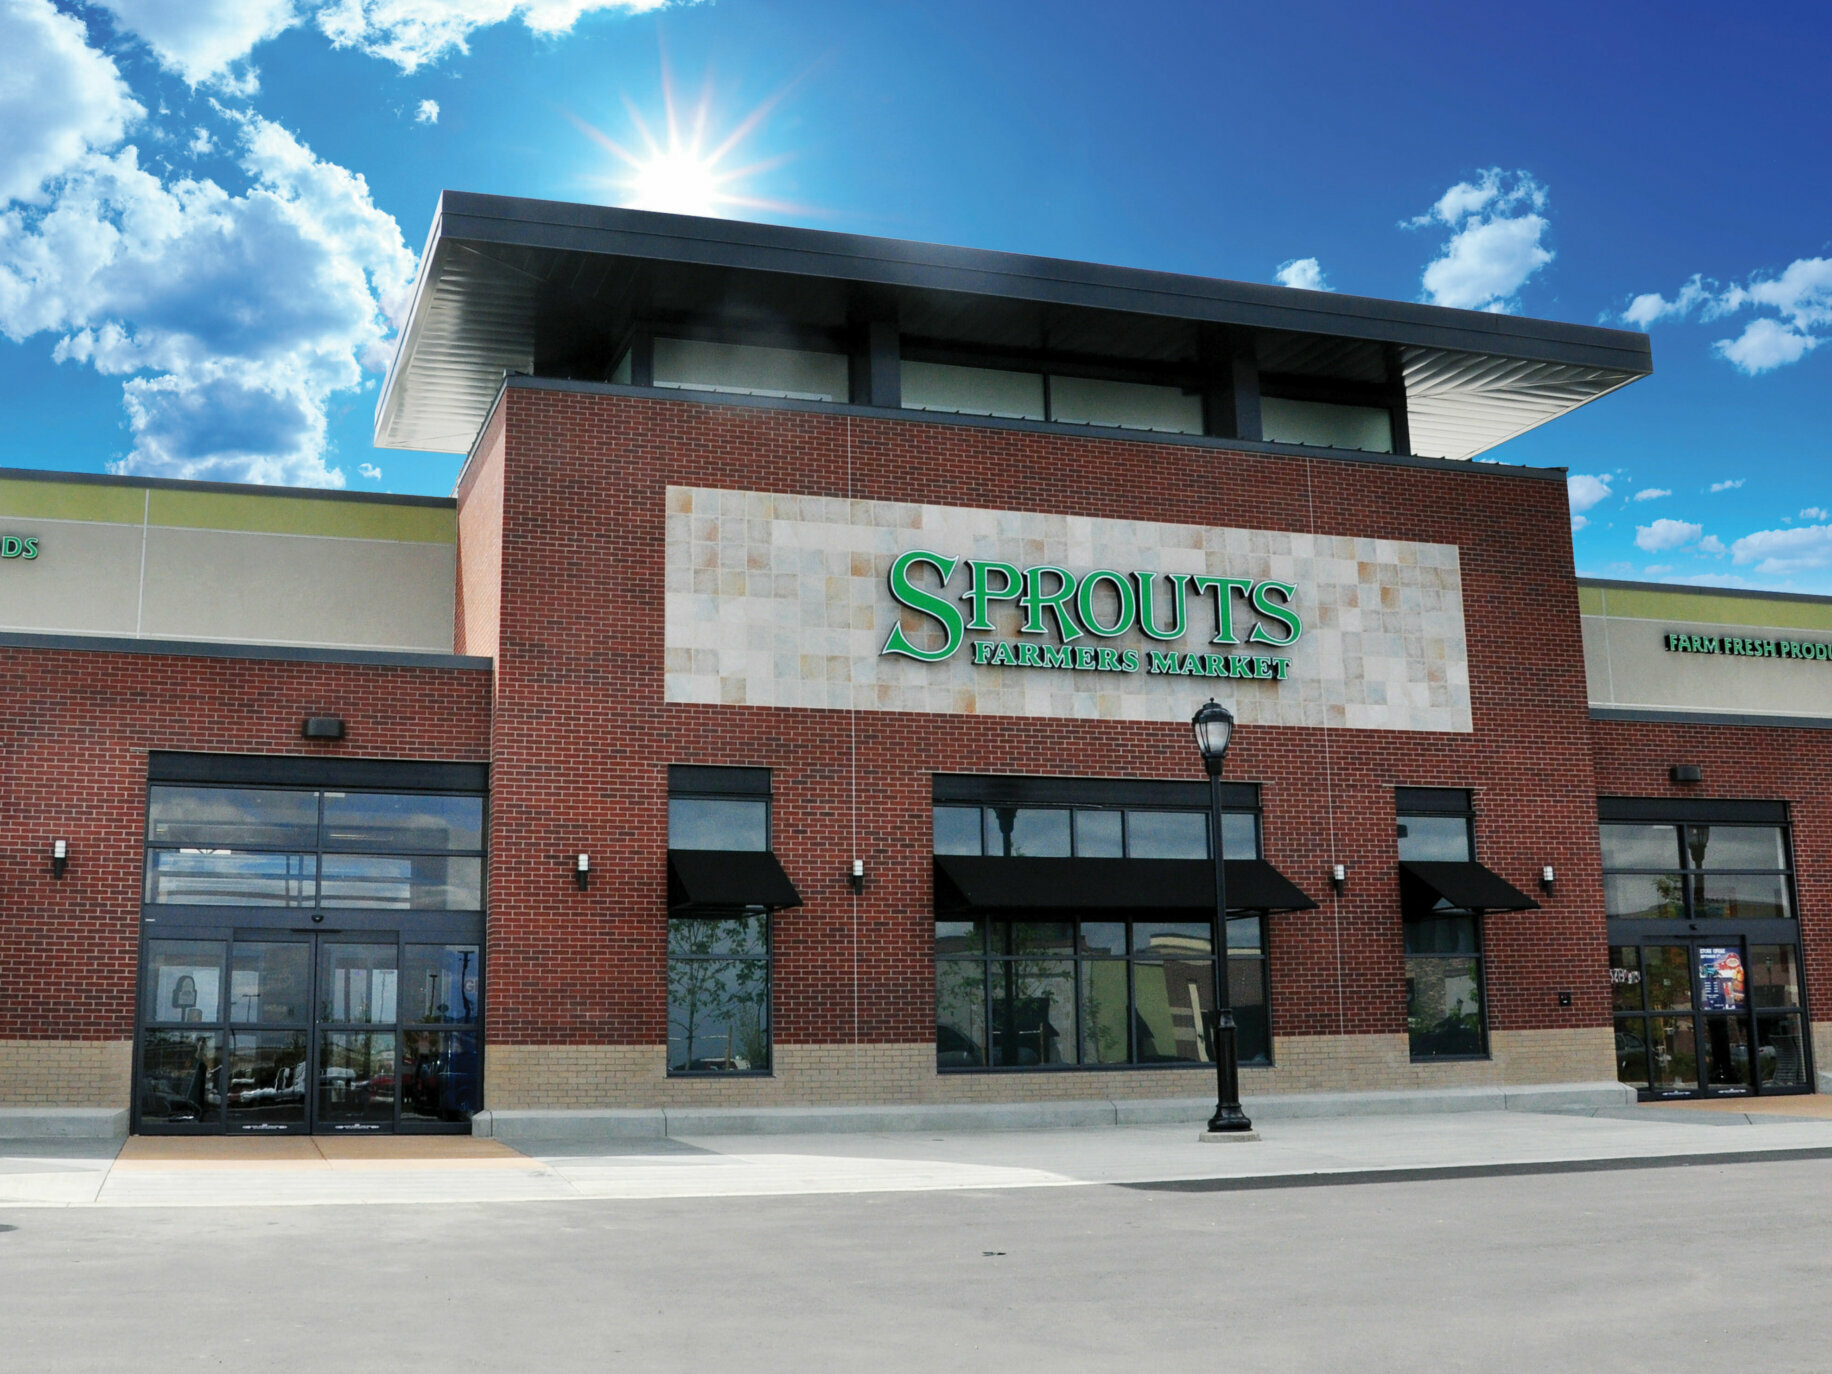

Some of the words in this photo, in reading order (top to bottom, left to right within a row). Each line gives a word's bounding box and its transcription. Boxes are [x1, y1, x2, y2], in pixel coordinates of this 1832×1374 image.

[882, 548, 1302, 663] SPROUTS
[972, 639, 1140, 673] FARMERS
[1150, 651, 1293, 681] MARKET
[1668, 633, 1719, 654] FARM
[1722, 637, 1776, 657] FRESH
